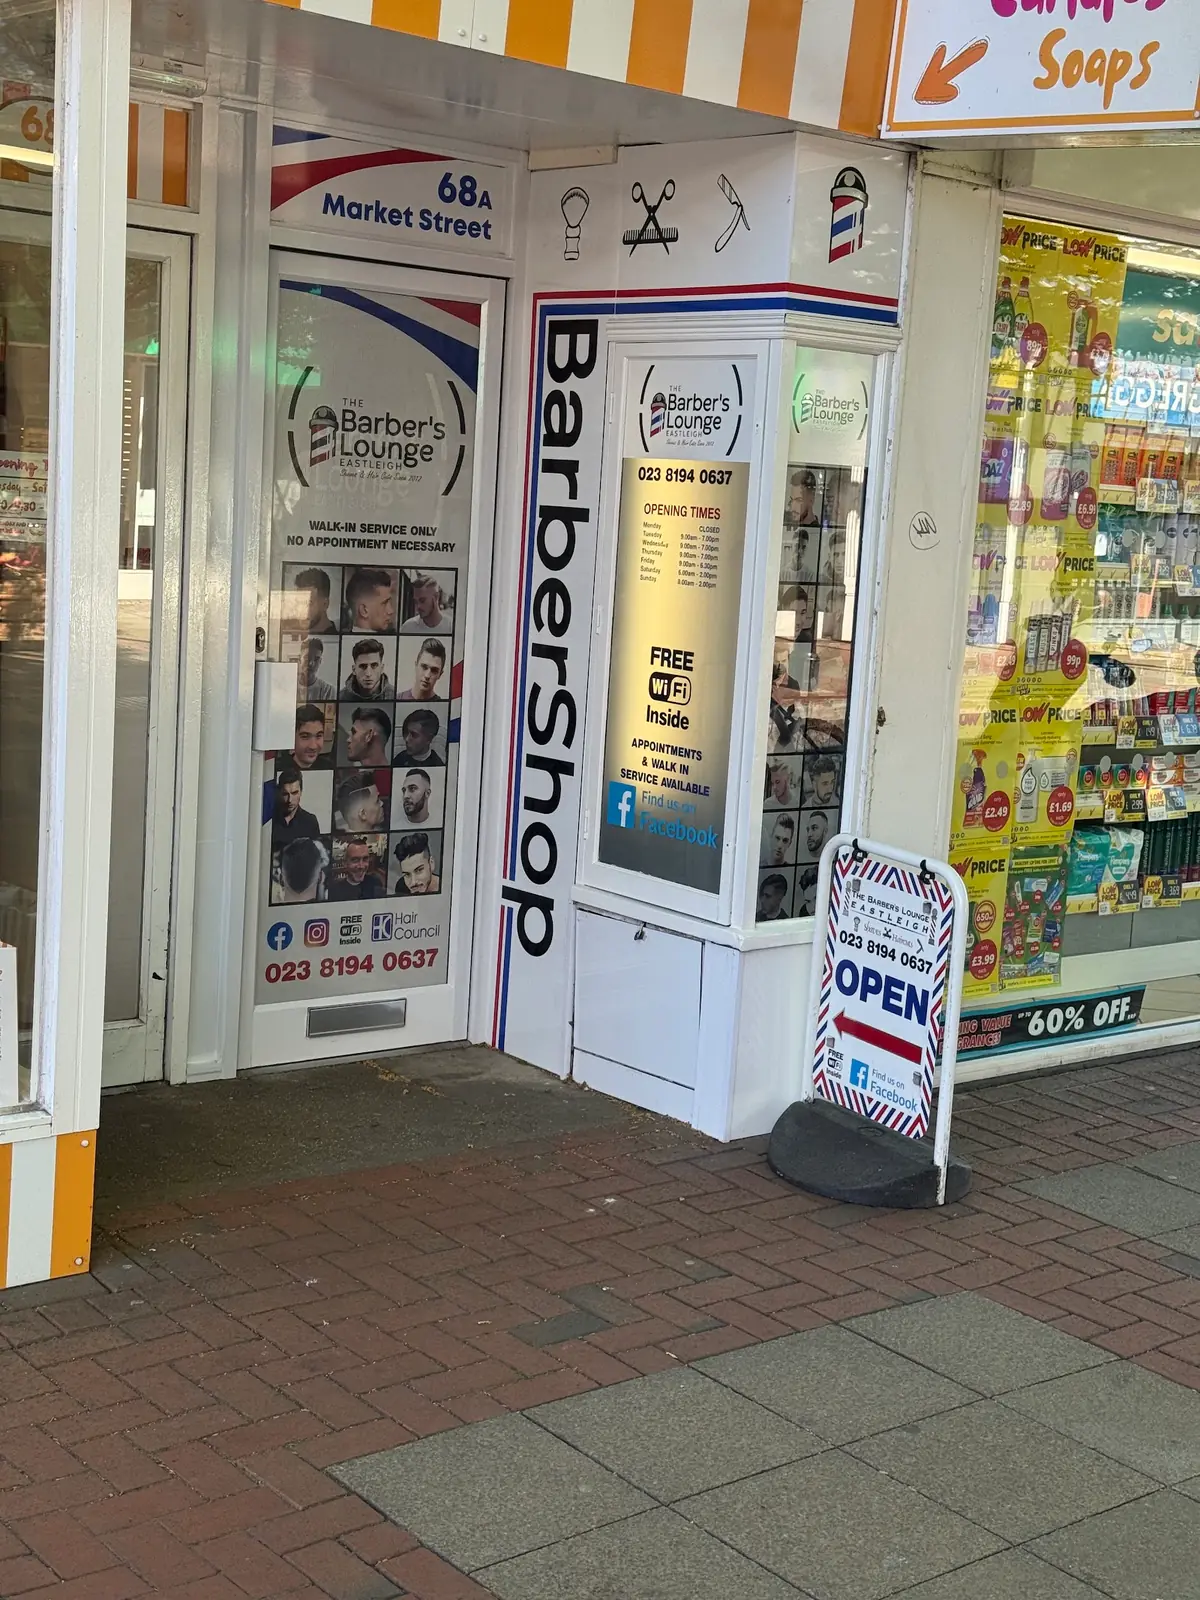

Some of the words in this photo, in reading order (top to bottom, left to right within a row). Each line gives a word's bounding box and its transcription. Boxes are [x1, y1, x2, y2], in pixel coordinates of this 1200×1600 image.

[1033, 28, 1160, 110] Soaps
[438, 172, 492, 210] 68A
[322, 192, 414, 228] Market
[419, 208, 492, 240] Street
[1022, 231, 1057, 251] PRICE
[1063, 237, 1097, 257] LOW
[1094, 244, 1126, 262] PRICE
[342, 398, 364, 408] THE
[668, 393, 730, 412] Barber's
[814, 395, 860, 411] Barber's
[985, 390, 1011, 411] OW
[341, 409, 446, 441] Barber's
[666, 412, 722, 435] Lounge
[813, 407, 854, 425] Lounge
[665, 430, 703, 438] EASTLEIGH
[340, 433, 434, 468] Lounge
[339, 459, 402, 471] EASTLEIGH
[638, 467, 661, 480] 023
[665, 468, 695, 483] 8194
[699, 469, 733, 485] 0637
[644, 503, 688, 518] OPENING
[690, 506, 721, 521] TIMES
[309, 520, 356, 533] WALK-IN
[360, 523, 407, 536] SERVICE
[410, 526, 438, 537] ONLY
[643, 521, 662, 530] Monday
[699, 525, 720, 534] CLOSED
[643, 530, 663, 539] Tuesday
[287, 535, 304, 547] NO
[308, 536, 389, 551] APPOINTMENT
[391, 540, 457, 553] NECESSARY
[641, 547, 663, 557] Thursday
[640, 556, 656, 565] Friday
[1063, 556, 1095, 574] PRICE
[639, 574, 657, 583] Sunday
[640, 565, 661, 575] Saturday
[650, 646, 694, 671] FREE
[1066, 654, 1081, 669] 99p
[646, 705, 690, 730] Inside
[983, 709, 1016, 727] PRICE
[1048, 706, 1081, 724] PRICE
[631, 738, 703, 761] APPOINTMENTS
[641, 756, 649, 767] &
[651, 758, 677, 773] WALK
[679, 764, 690, 776] IN
[620, 768, 658, 786] SERVICE
[660, 776, 711, 797] AVAILABLE
[641, 791, 664, 808] Find
[666, 799, 679, 812] us
[1049, 801, 1072, 813] £1.69
[984, 806, 1008, 819] £2.49
[639, 811, 719, 848] Facebook
[971, 859, 1006, 879] PRICE
[852, 890, 866, 902] THE
[340, 915, 363, 924] FREE
[395, 911, 418, 925] Hair
[850, 901, 929, 934] EASTLEIGH
[339, 937, 362, 946] Inside
[393, 924, 441, 941] Council
[839, 930, 863, 950] 023
[866, 939, 896, 962] 8194
[900, 951, 933, 975] 0637
[971, 953, 996, 968] £3.99
[265, 960, 312, 984] 023
[319, 954, 375, 978] 8194
[382, 948, 440, 972] 0637
[835, 958, 930, 1028] OPEN
[1093, 996, 1132, 1026] OFF
[980, 1014, 1013, 1032] VALUE
[1027, 1004, 1086, 1037] 60%
[828, 1048, 844, 1061] FREE
[826, 1067, 842, 1079] Inside
[871, 1068, 886, 1082] Find
[887, 1078, 895, 1087] us
[896, 1081, 905, 1091] on
[870, 1080, 918, 1113] Facebook
